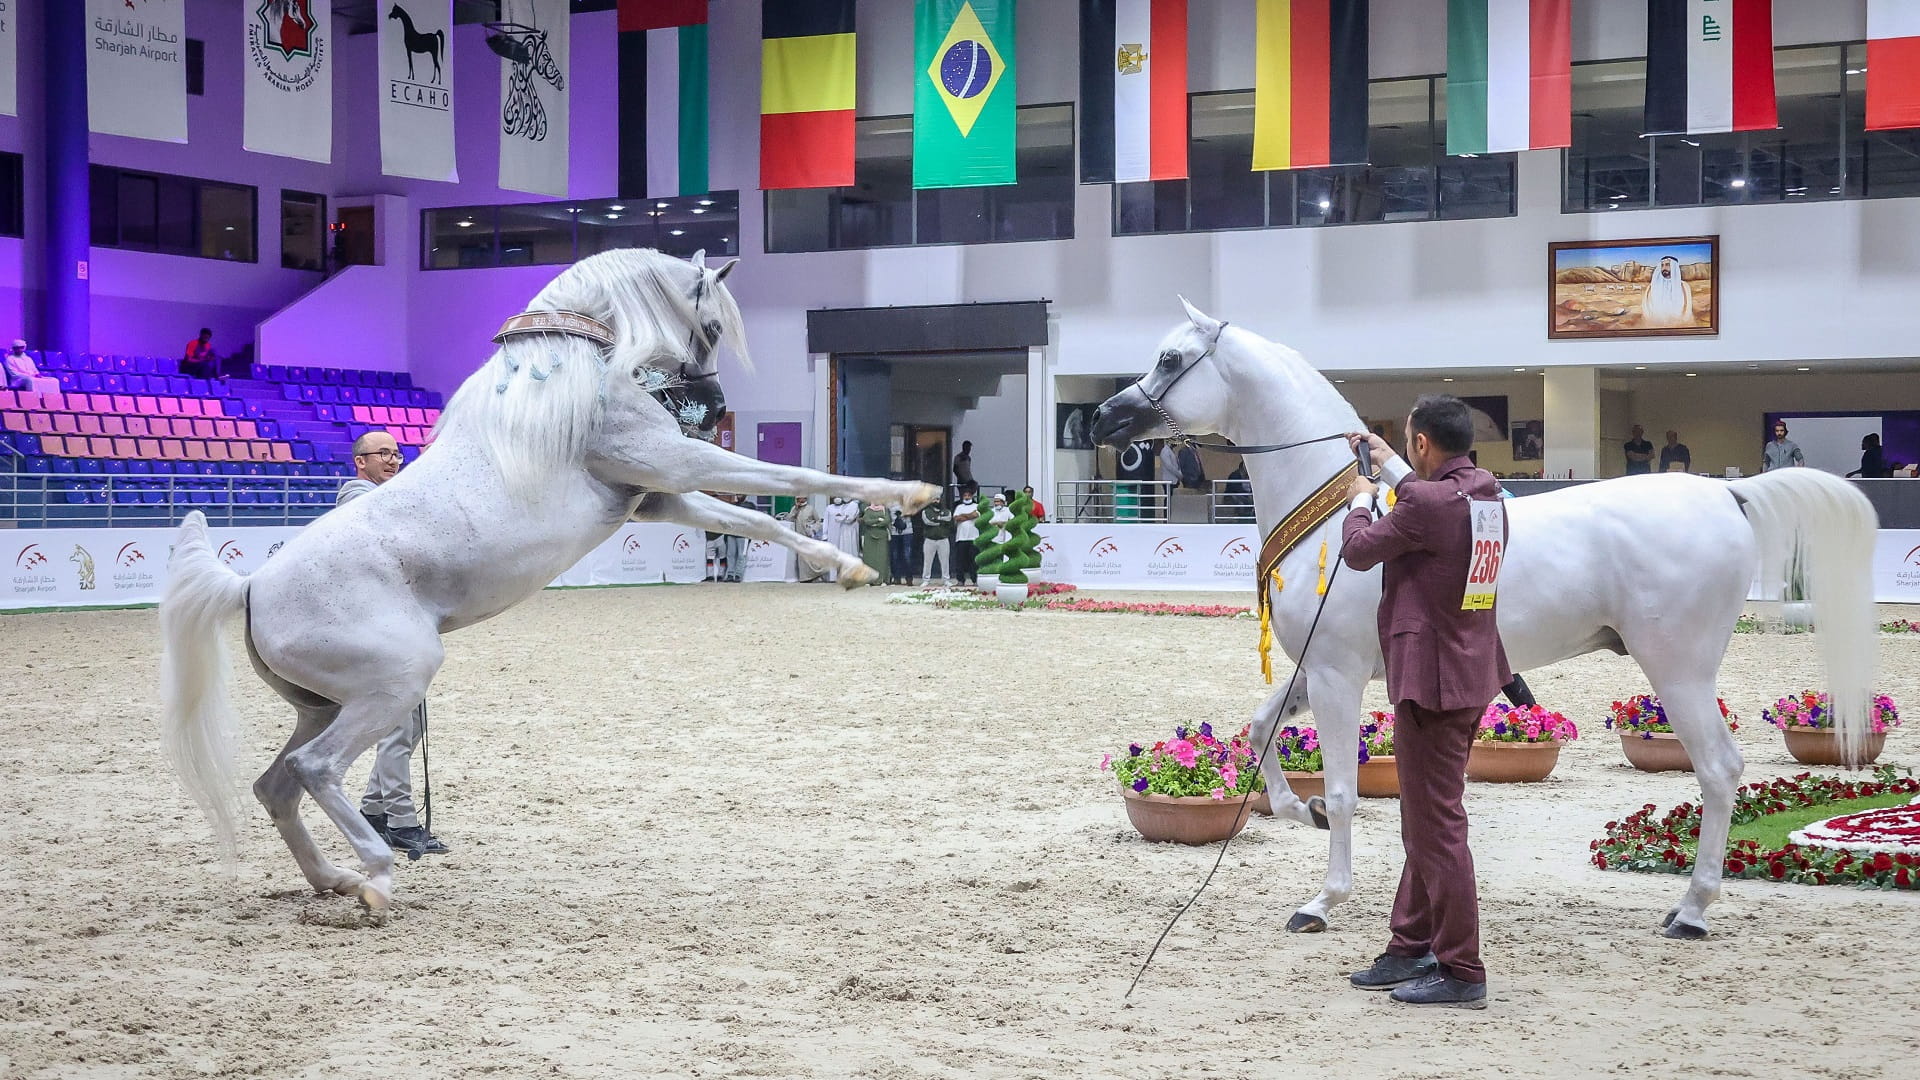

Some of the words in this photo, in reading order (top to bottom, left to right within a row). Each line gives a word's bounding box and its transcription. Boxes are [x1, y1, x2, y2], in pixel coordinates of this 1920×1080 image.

[95, 17, 143, 38] الشارقة
[147, 25, 178, 43] مطار
[95, 37, 137, 56] Sharjah
[139, 45, 178, 62] Airport
[249, 23, 262, 68] EMIRATES
[264, 72, 291, 92] ARABIAN
[295, 76, 315, 92] HORSE
[315, 38, 324, 72] SOCIETY
[391, 83, 449, 107] ECAHO
[1469, 540, 1501, 584] 236
